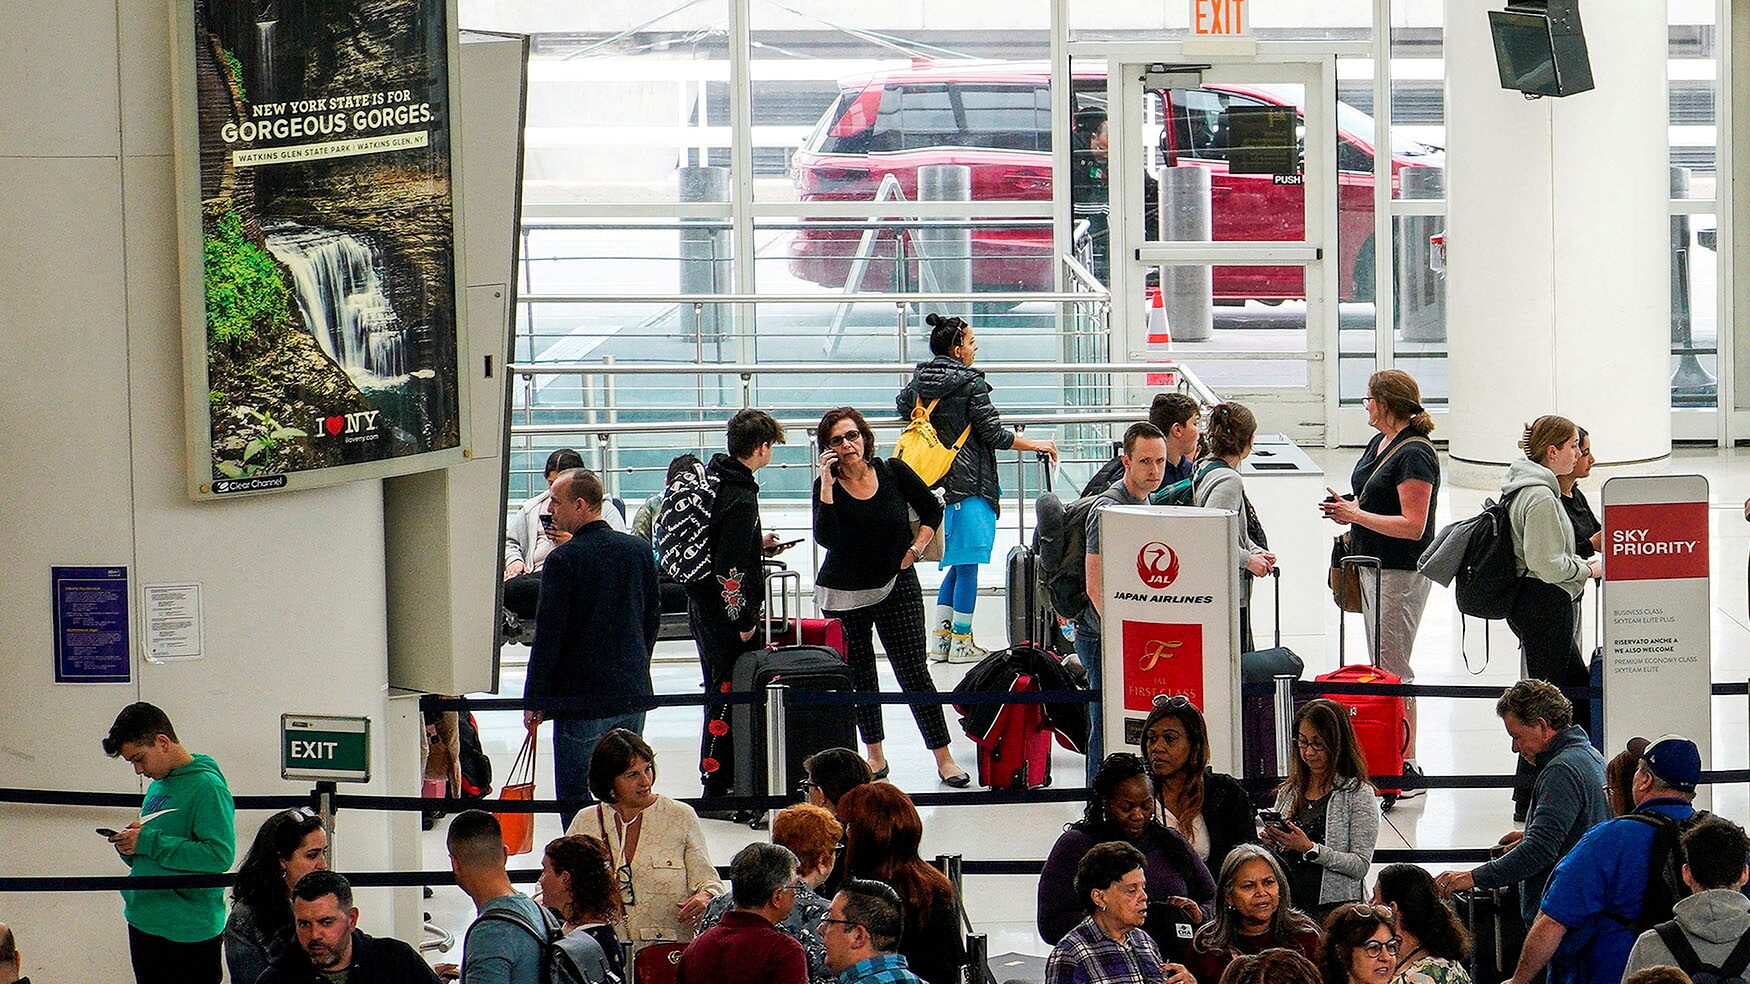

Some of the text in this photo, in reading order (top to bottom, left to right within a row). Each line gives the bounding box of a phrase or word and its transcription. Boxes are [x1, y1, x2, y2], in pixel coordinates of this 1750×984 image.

[1195, 0, 1245, 34] EXIT
[252, 89, 412, 118] NEW YORK STATE IS FOR
[220, 102, 436, 144] GORGEOUS GORGES.
[238, 151, 279, 163] WATKINS
[280, 149, 303, 160] GLEN
[304, 146, 329, 157] STATE
[330, 144, 351, 155] PARK
[357, 139, 391, 151] WATKINS
[414, 135, 425, 145] NY
[1274, 175, 1301, 184] PUSH
[314, 410, 380, 438] I NY
[345, 434, 379, 444] iloveny.com
[229, 477, 282, 491] Clear Channel
[1612, 529, 1649, 542] SKY
[1613, 541, 1696, 556] PRIORITY
[1147, 575, 1171, 584] JAL
[1114, 591, 1213, 604] JAPAN AIRLINES
[1128, 685, 1197, 699] FIRST CLASS
[291, 740, 338, 760] EXIT
